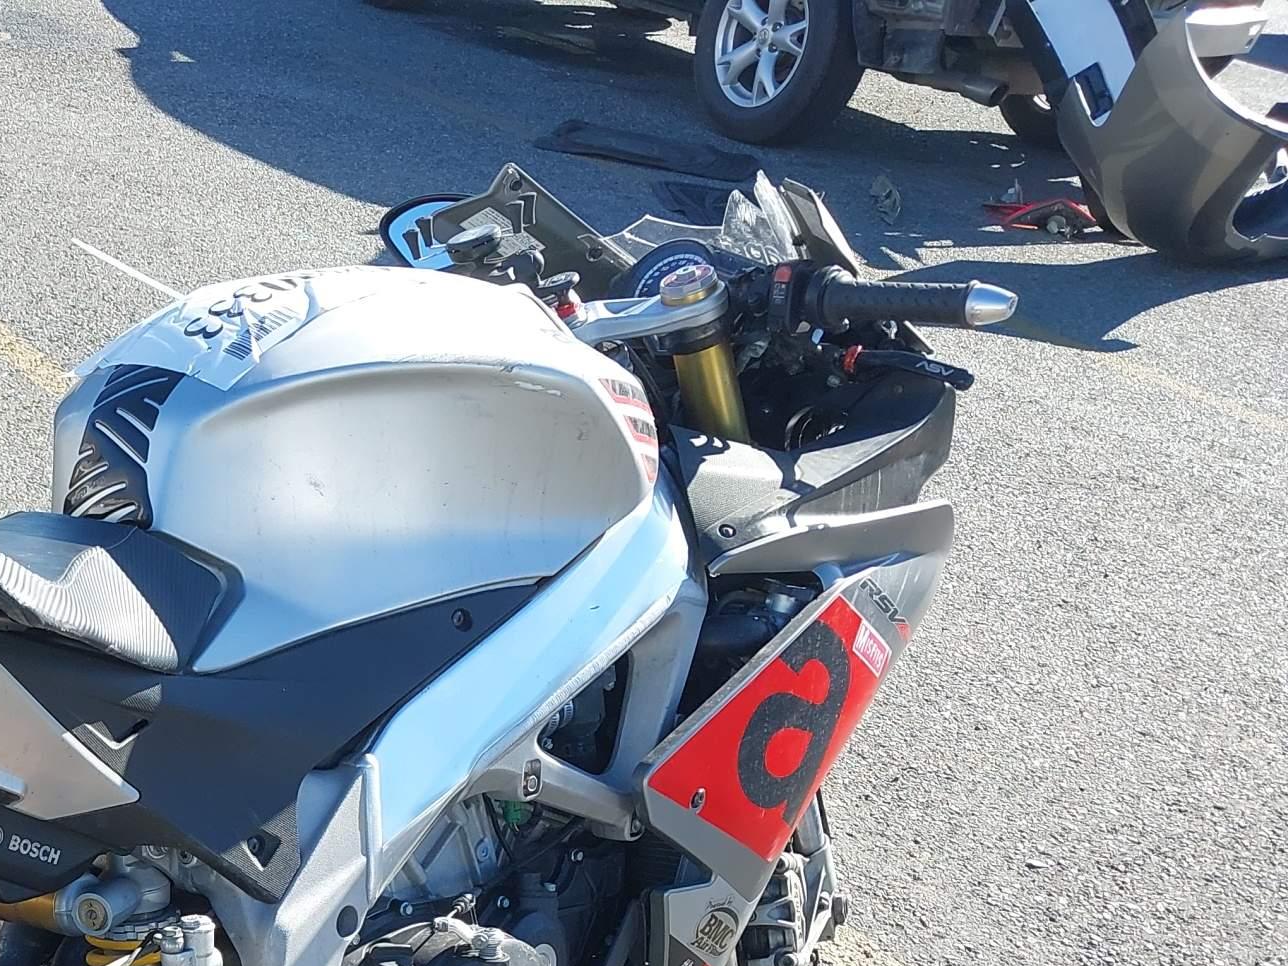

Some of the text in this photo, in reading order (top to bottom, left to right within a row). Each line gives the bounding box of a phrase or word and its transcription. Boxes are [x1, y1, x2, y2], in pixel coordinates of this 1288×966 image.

[914, 361, 955, 377] ASV
[8, 834, 61, 865] BOSCH
[699, 912, 734, 950] BMC
